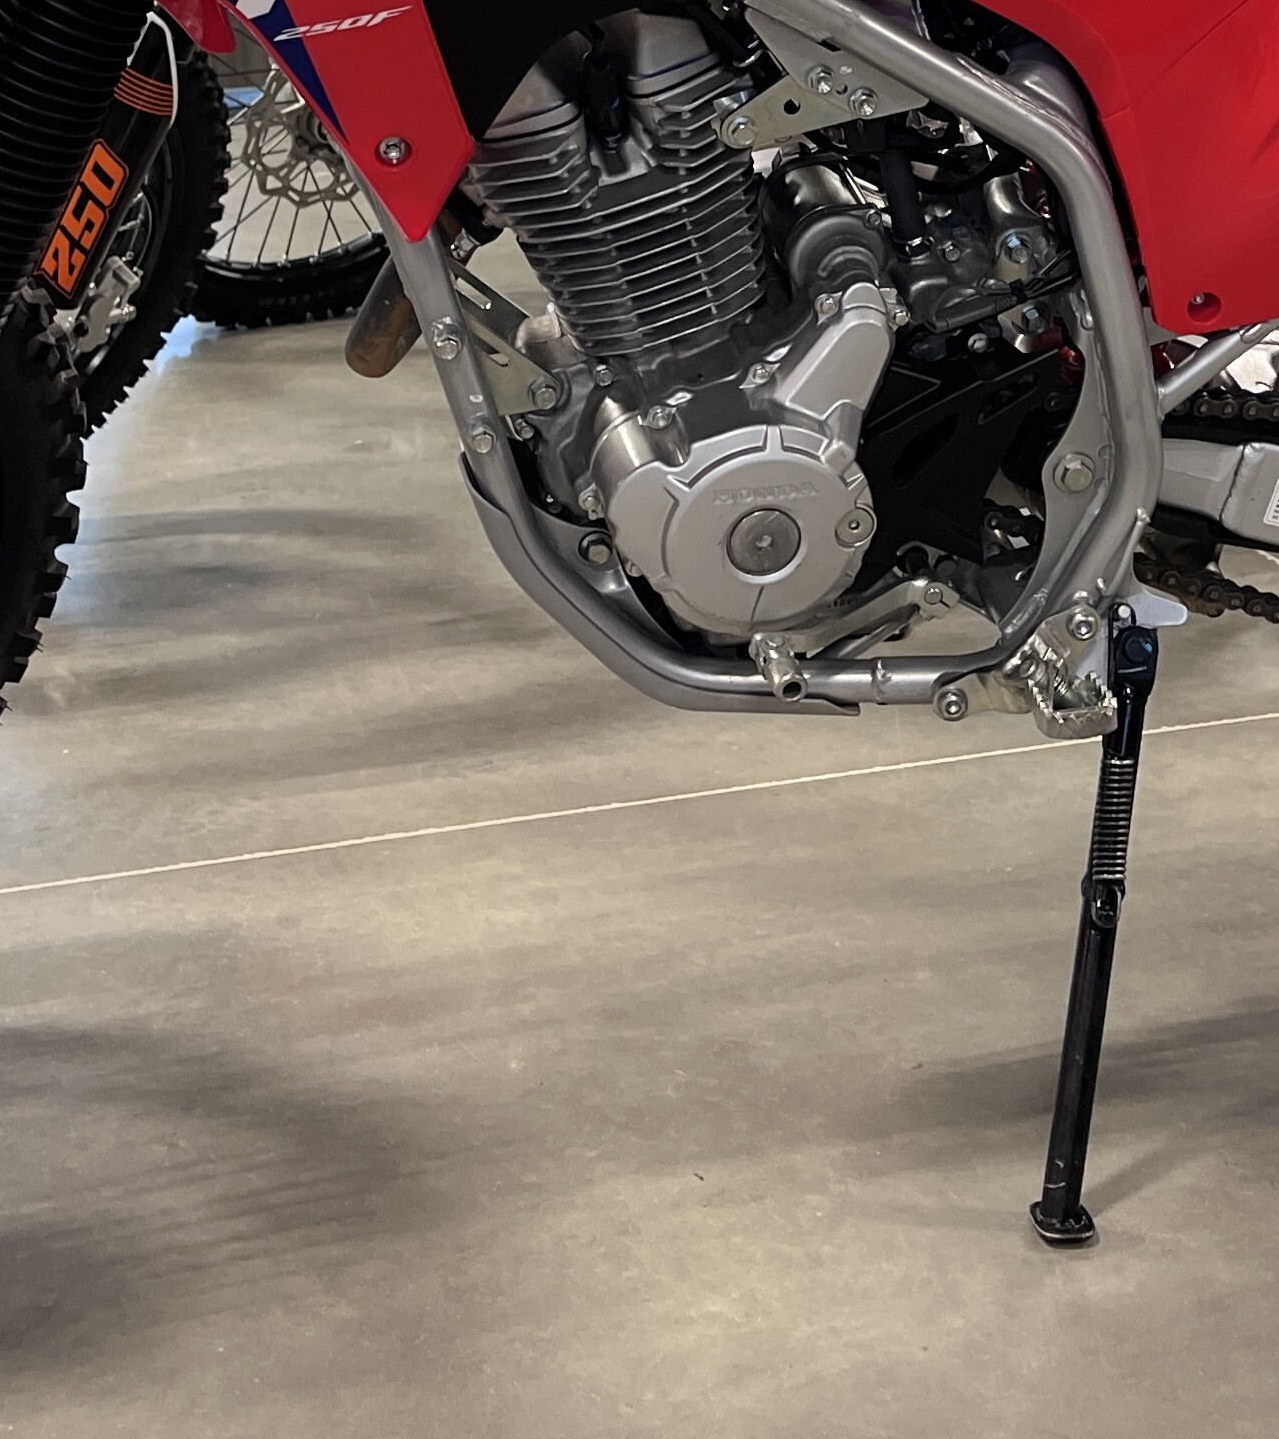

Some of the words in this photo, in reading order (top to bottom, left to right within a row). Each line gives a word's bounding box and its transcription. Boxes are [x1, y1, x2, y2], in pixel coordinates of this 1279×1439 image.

[273, 5, 413, 42] 250F
[40, 143, 126, 293] 250
[713, 482, 820, 504] HONDA
